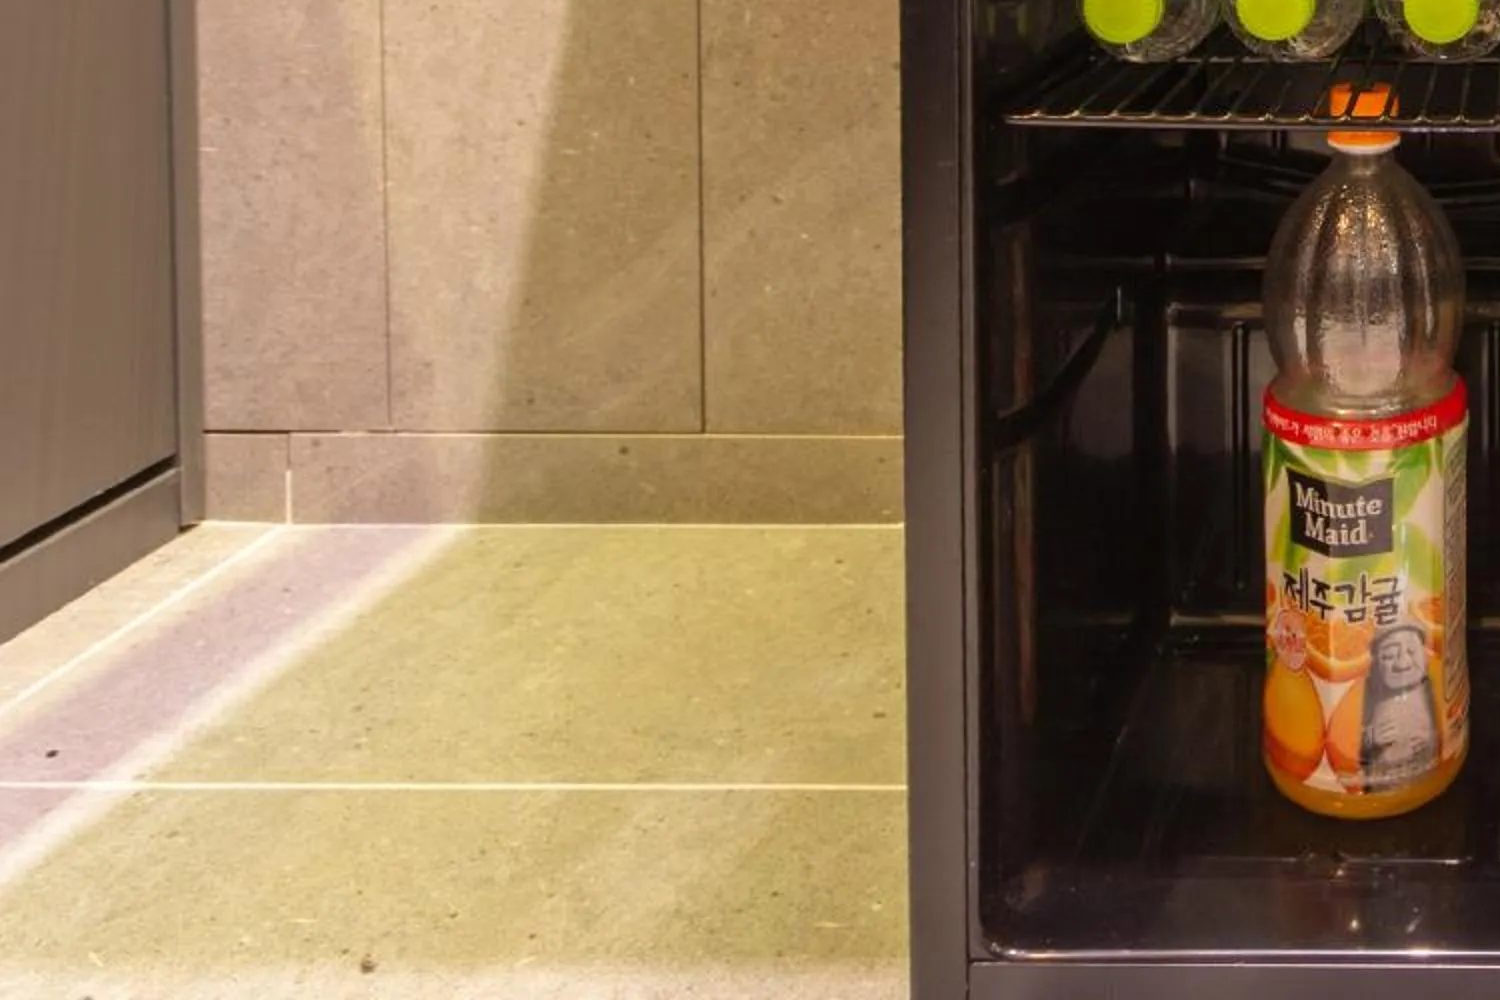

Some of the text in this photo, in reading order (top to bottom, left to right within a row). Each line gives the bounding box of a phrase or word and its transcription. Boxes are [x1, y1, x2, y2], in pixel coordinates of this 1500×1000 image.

[1294, 482, 1382, 517] Minute
[1304, 512, 1369, 546] Maid
[1282, 567, 1404, 625] 제주감귤
